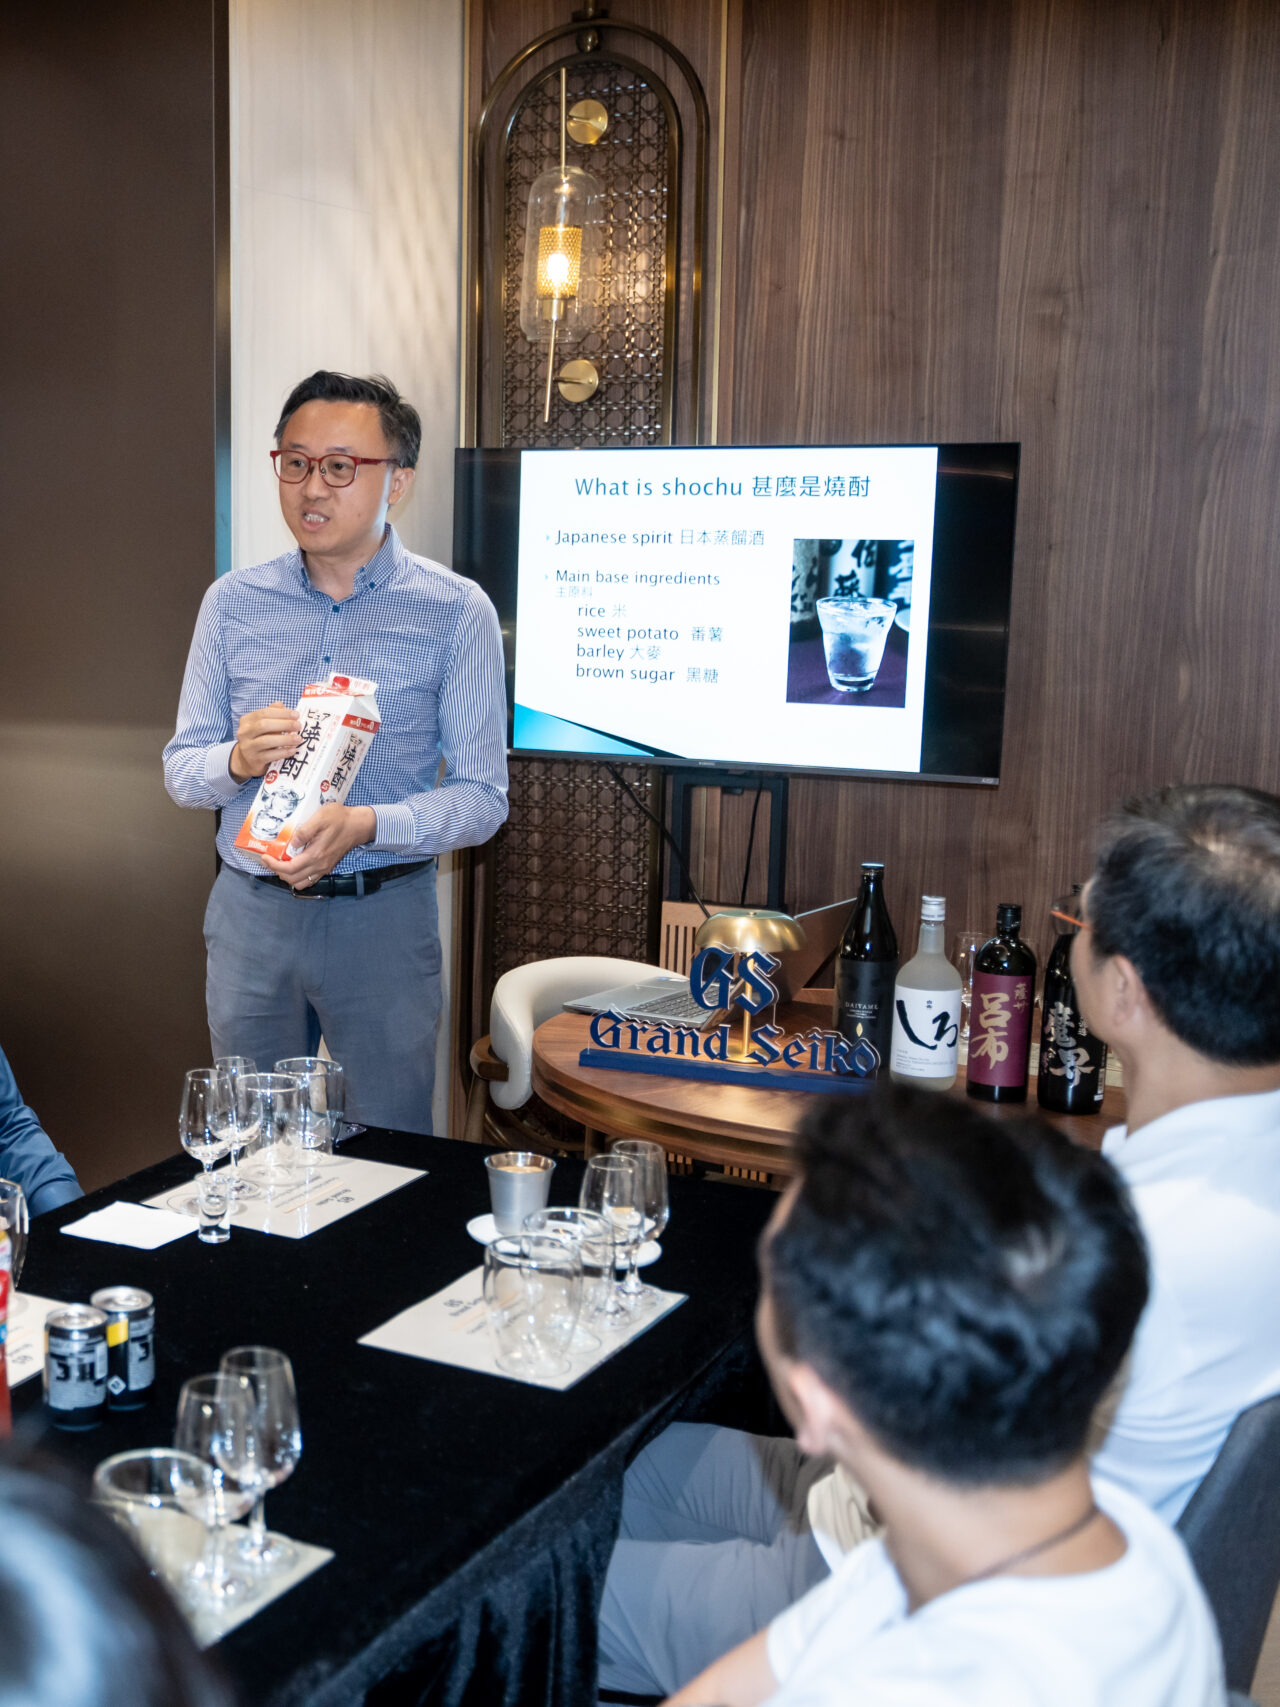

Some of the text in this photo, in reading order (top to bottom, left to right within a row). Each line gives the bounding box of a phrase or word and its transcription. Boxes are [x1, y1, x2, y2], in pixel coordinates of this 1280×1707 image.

[575, 475, 871, 498] What is shochu 甚麼是燒酎
[554, 528, 765, 547] Japanese spirit 日本蒸餾酒
[555, 569, 721, 587] Main base ingredients
[577, 603, 627, 619] rice 米
[577, 626, 621, 639] sweet
[627, 627, 680, 642] potato
[576, 643, 662, 661] barley 大麥
[575, 663, 624, 680] brown
[630, 668, 676, 684] sugar
[689, 946, 780, 1017] GS
[895, 999, 959, 1051] しろ
[970, 992, 1012, 1070] 呂布
[589, 1008, 731, 1061] Grand
[746, 1022, 878, 1078] Seiko
